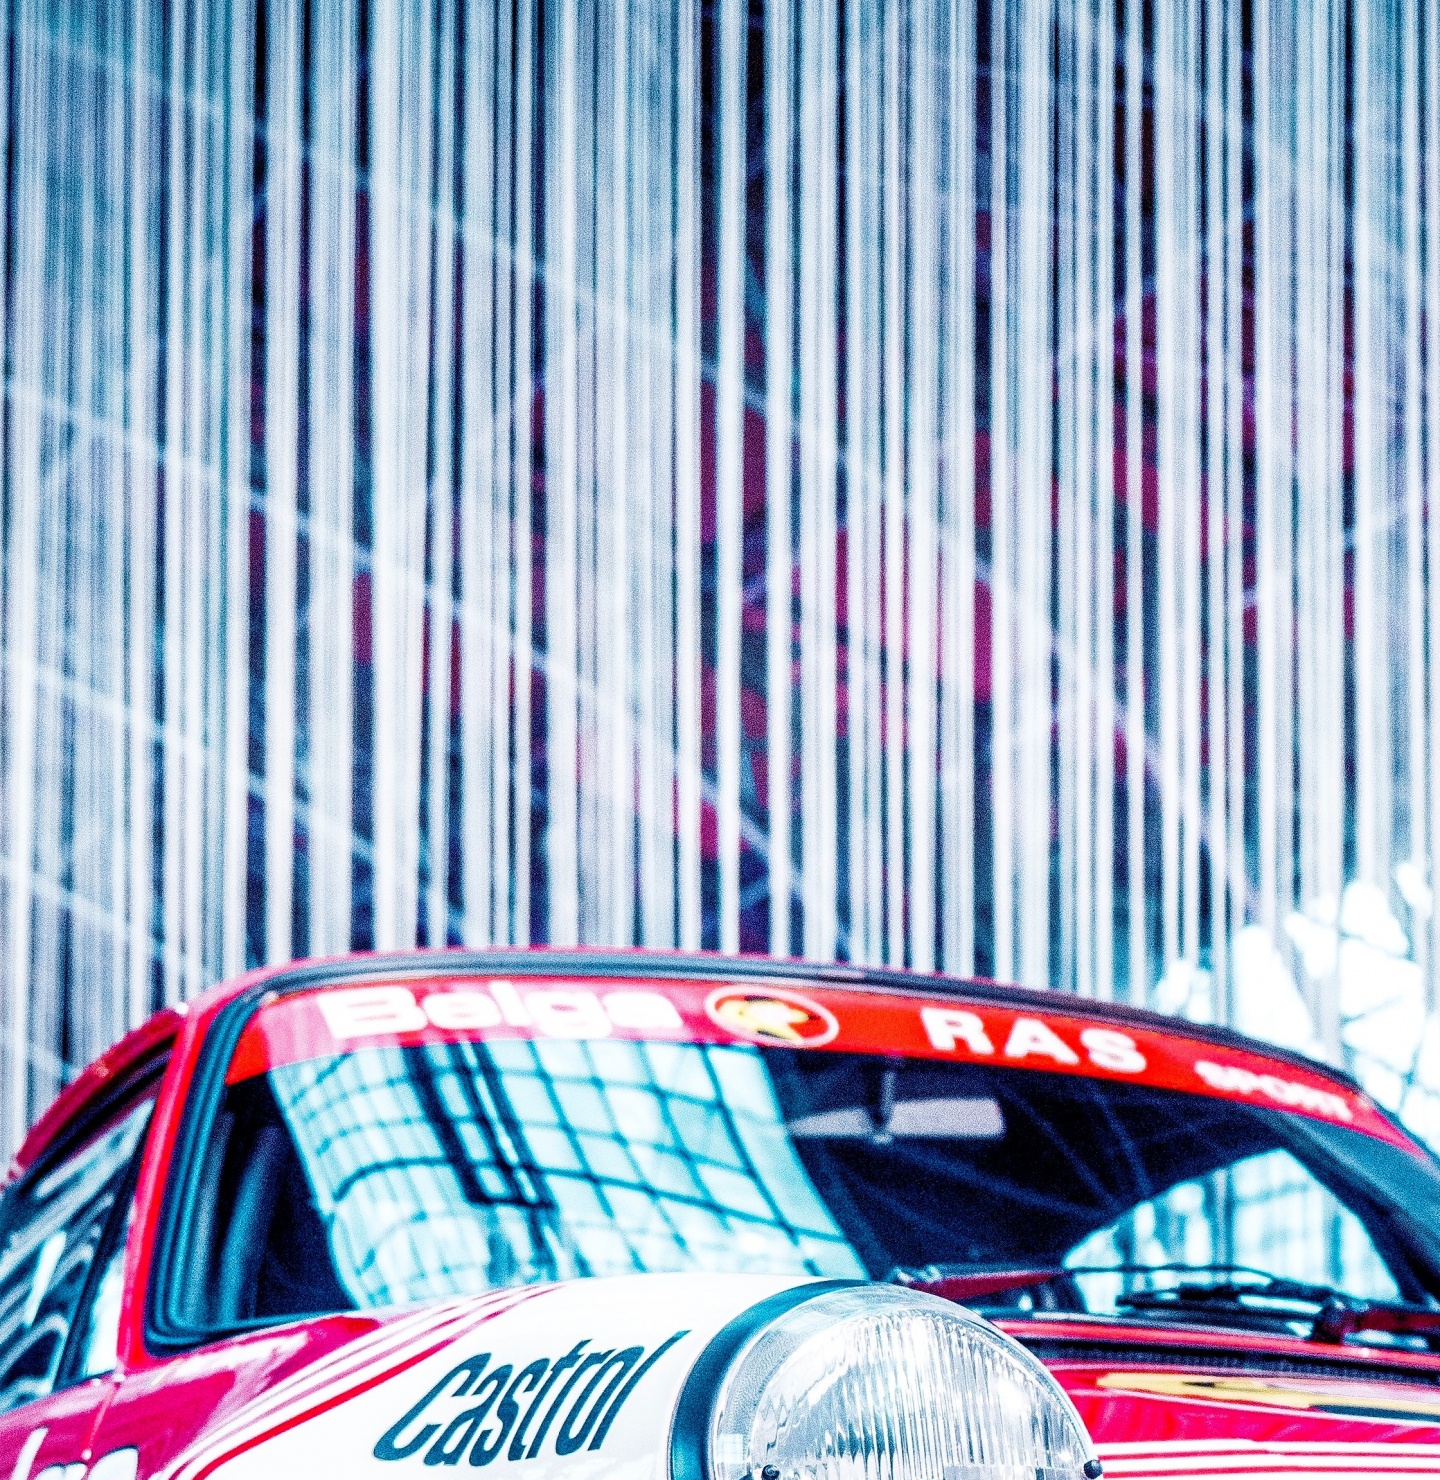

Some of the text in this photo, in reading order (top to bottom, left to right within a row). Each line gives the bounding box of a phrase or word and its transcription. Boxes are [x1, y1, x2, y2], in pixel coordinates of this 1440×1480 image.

[316, 979, 684, 1039] Belga
[920, 1006, 1147, 1074] RAS
[373, 1329, 691, 1466] Castrol
